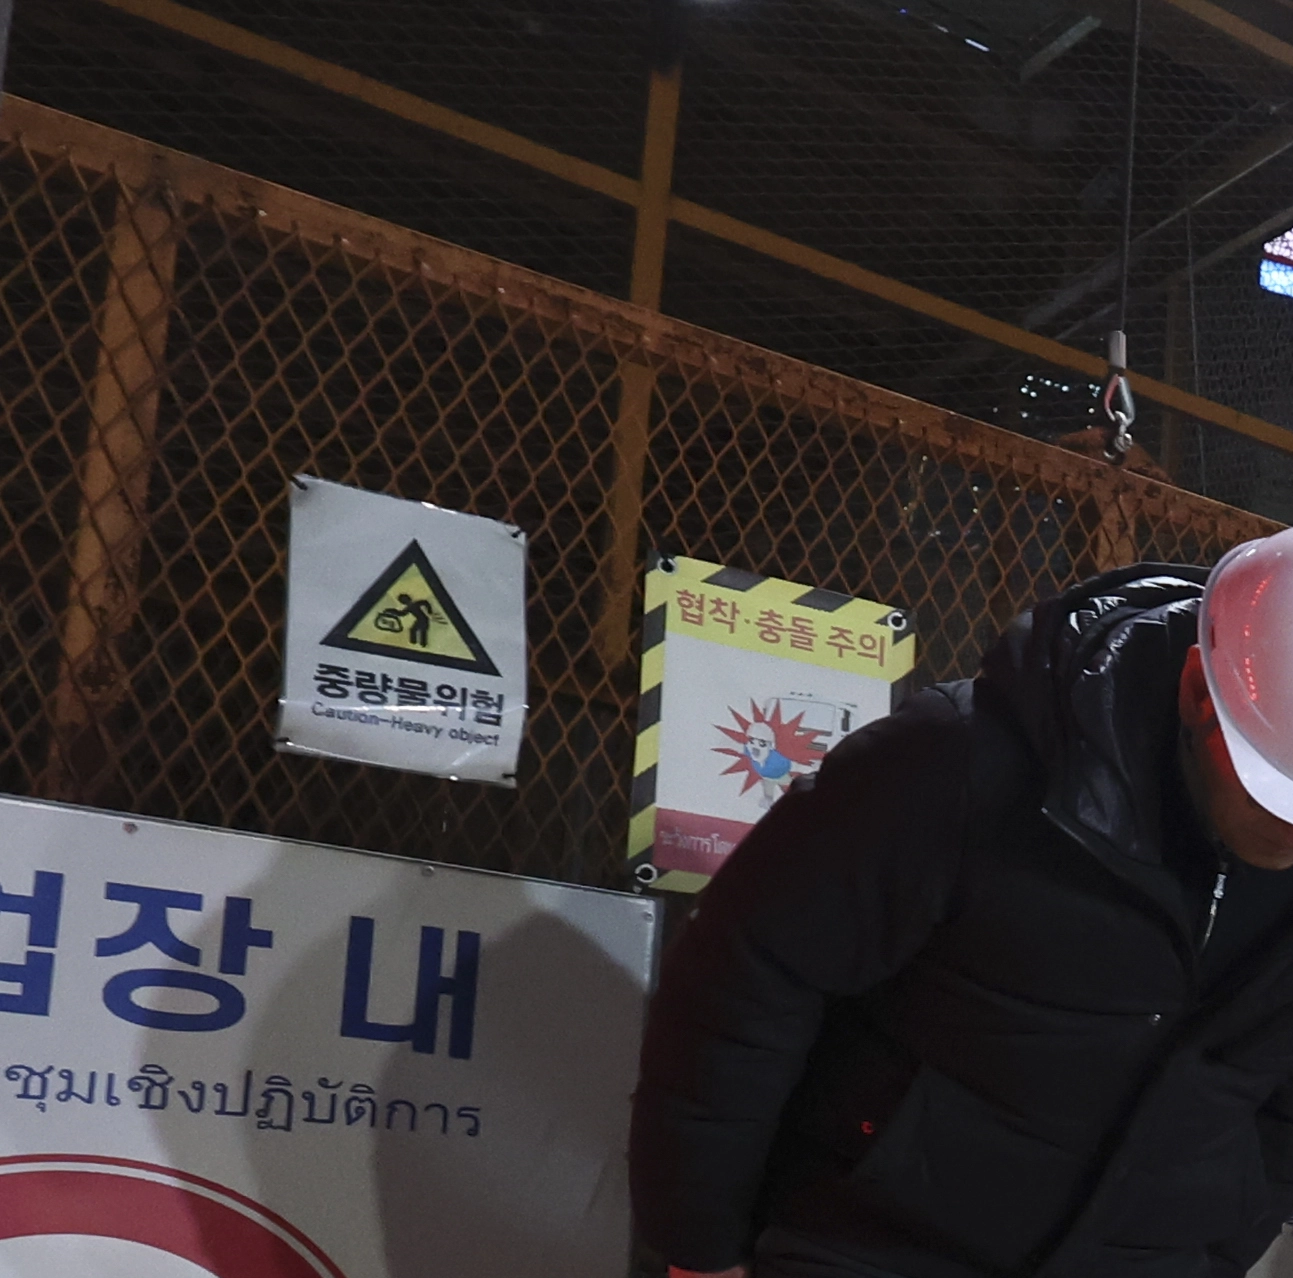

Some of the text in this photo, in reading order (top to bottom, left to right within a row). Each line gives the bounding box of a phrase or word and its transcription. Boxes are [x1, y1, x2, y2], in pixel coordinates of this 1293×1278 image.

[826, 625, 886, 668] 주의
[313, 662, 505, 727] 중량물위험
[448, 727, 500, 746] object
[339, 915, 481, 1060] 내
